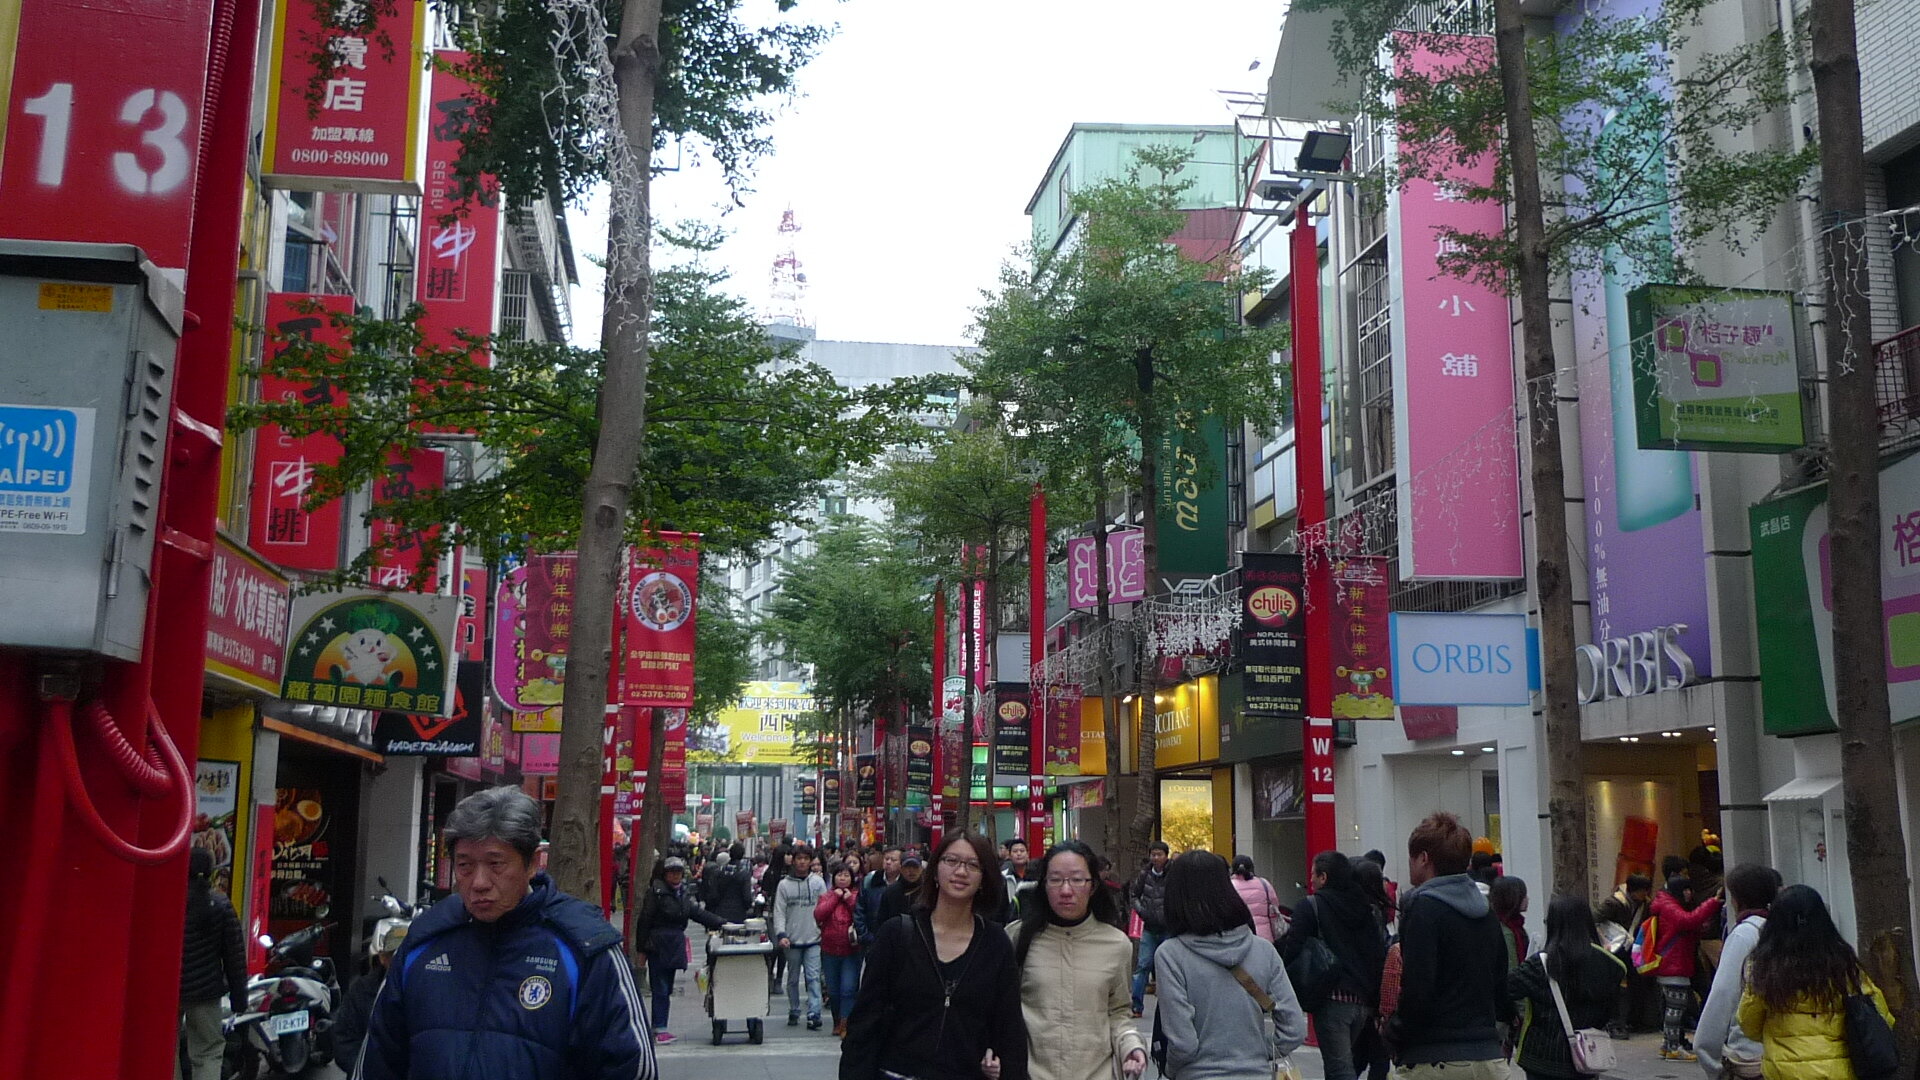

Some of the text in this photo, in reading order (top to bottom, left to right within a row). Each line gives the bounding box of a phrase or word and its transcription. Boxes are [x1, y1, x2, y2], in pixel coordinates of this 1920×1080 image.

[324, 0, 368, 111] 賣店
[24, 82, 190, 194] 13
[312, 126, 375, 143] 加盟專線
[291, 148, 389, 166] 0800-898000
[0, 509, 69, 521] PE-Free Wi-Fi
[550, 563, 571, 638] 新年快樂
[1252, 592, 1292, 614] chili's
[1349, 587, 1368, 657] 新年快樂
[1412, 642, 1513, 674] ORBIS
[1576, 623, 1695, 705] ORBIS
[741, 732, 788, 742] Welcome
[1312, 738, 1330, 755] W
[1312, 767, 1332, 782] 12
[1032, 786, 1043, 796] W
[933, 803, 941, 811] W
[1032, 802, 1043, 812] 10
[425, 963, 451, 972] adidas
[526, 955, 558, 967] SAMSUNG
